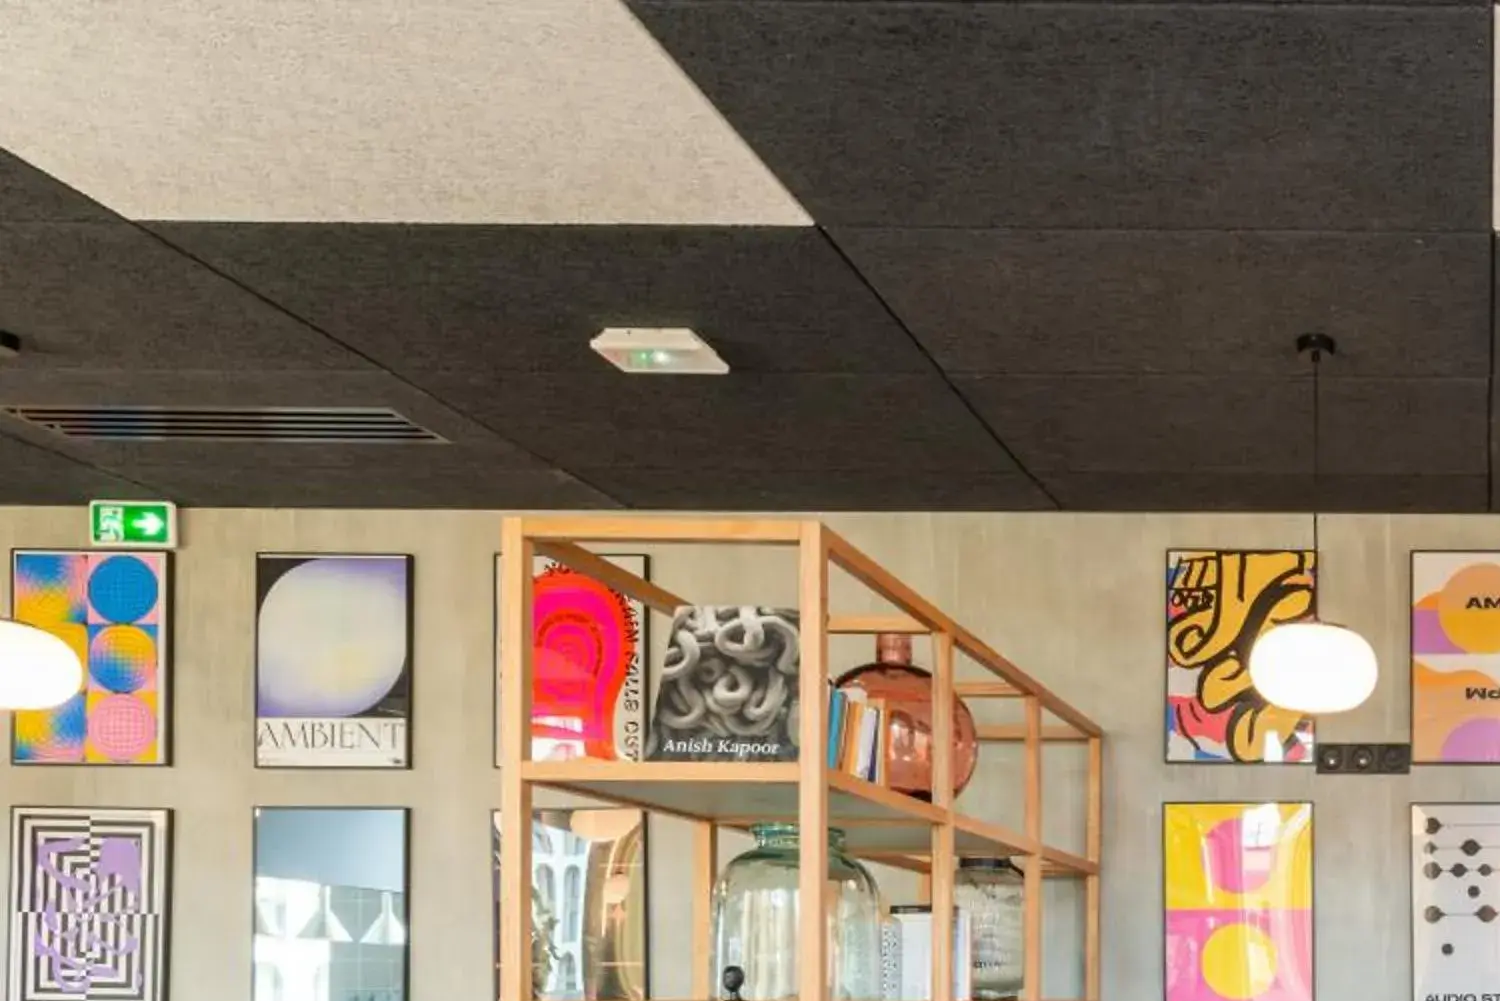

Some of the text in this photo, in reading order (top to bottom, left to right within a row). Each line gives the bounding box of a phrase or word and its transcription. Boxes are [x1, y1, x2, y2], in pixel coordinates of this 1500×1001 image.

[258, 721, 406, 749] AMBIENT
[663, 737, 781, 757] Anish Kapoor
